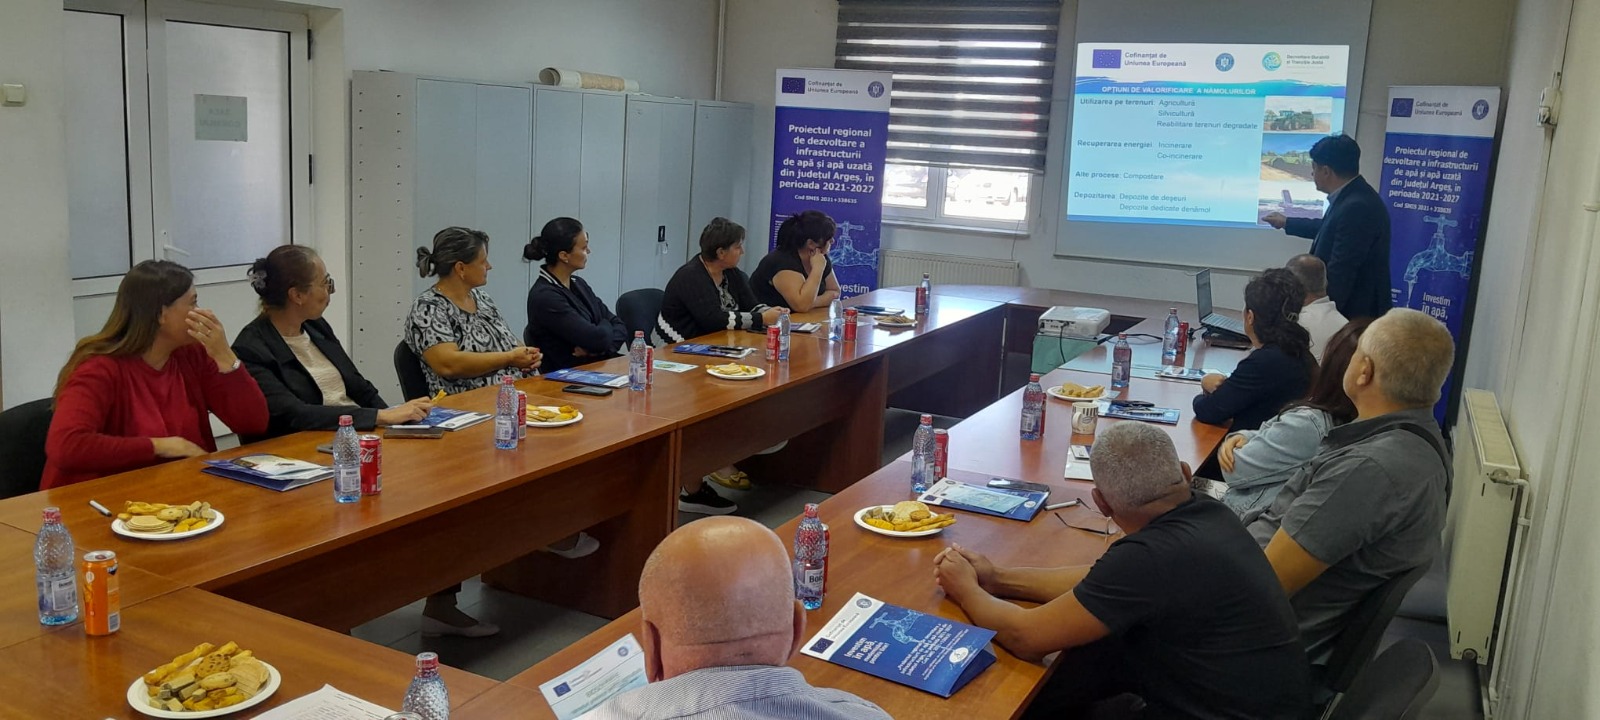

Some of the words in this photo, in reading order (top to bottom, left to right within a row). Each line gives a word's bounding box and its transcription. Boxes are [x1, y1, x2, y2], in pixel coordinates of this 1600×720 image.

[1124, 52, 1158, 60] Cofinanțat
[1102, 86, 1130, 94] OPȚIUNI
[1158, 99, 1196, 108] Agricultură
[788, 124, 830, 135] Proiectul
[833, 126, 872, 138] regional
[793, 136, 805, 144] de
[808, 136, 857, 148] dezvoltare
[1078, 140, 1122, 148] Recuperarea
[796, 147, 862, 159] infrastructurii
[1156, 152, 1203, 160] Co-incinerare
[1395, 146, 1428, 156] Proiectul
[1428, 148, 1458, 158] regional
[1459, 150, 1468, 158] de
[797, 160, 814, 168] apă
[816, 160, 825, 170] și
[827, 160, 844, 170] apă
[847, 162, 873, 171] uzată
[1384, 157, 1420, 166] dezvoltare
[1428, 158, 1478, 171] infrastructurii
[780, 168, 794, 177] din
[797, 170, 830, 180] județul
[833, 172, 862, 182] Argeș,
[866, 172, 874, 182] în
[1123, 172, 1164, 180] Compostare
[1405, 168, 1418, 178] apă
[1427, 170, 1440, 180] apă
[1442, 172, 1462, 180] uzată
[778, 180, 820, 190] perioada
[822, 182, 874, 193] 2021-2027
[1390, 178, 1402, 186] din
[1404, 179, 1428, 190] județul
[1074, 192, 1116, 200] Depozitarea
[1120, 193, 1149, 202] Depozite
[1388, 189, 1420, 199] perioada
[1421, 192, 1460, 202] 2021-2027
[1120, 204, 1149, 212] Depozite
[1150, 204, 1180, 212] dedicate
[840, 284, 870, 294] vestim
[1423, 292, 1451, 306] Investim
